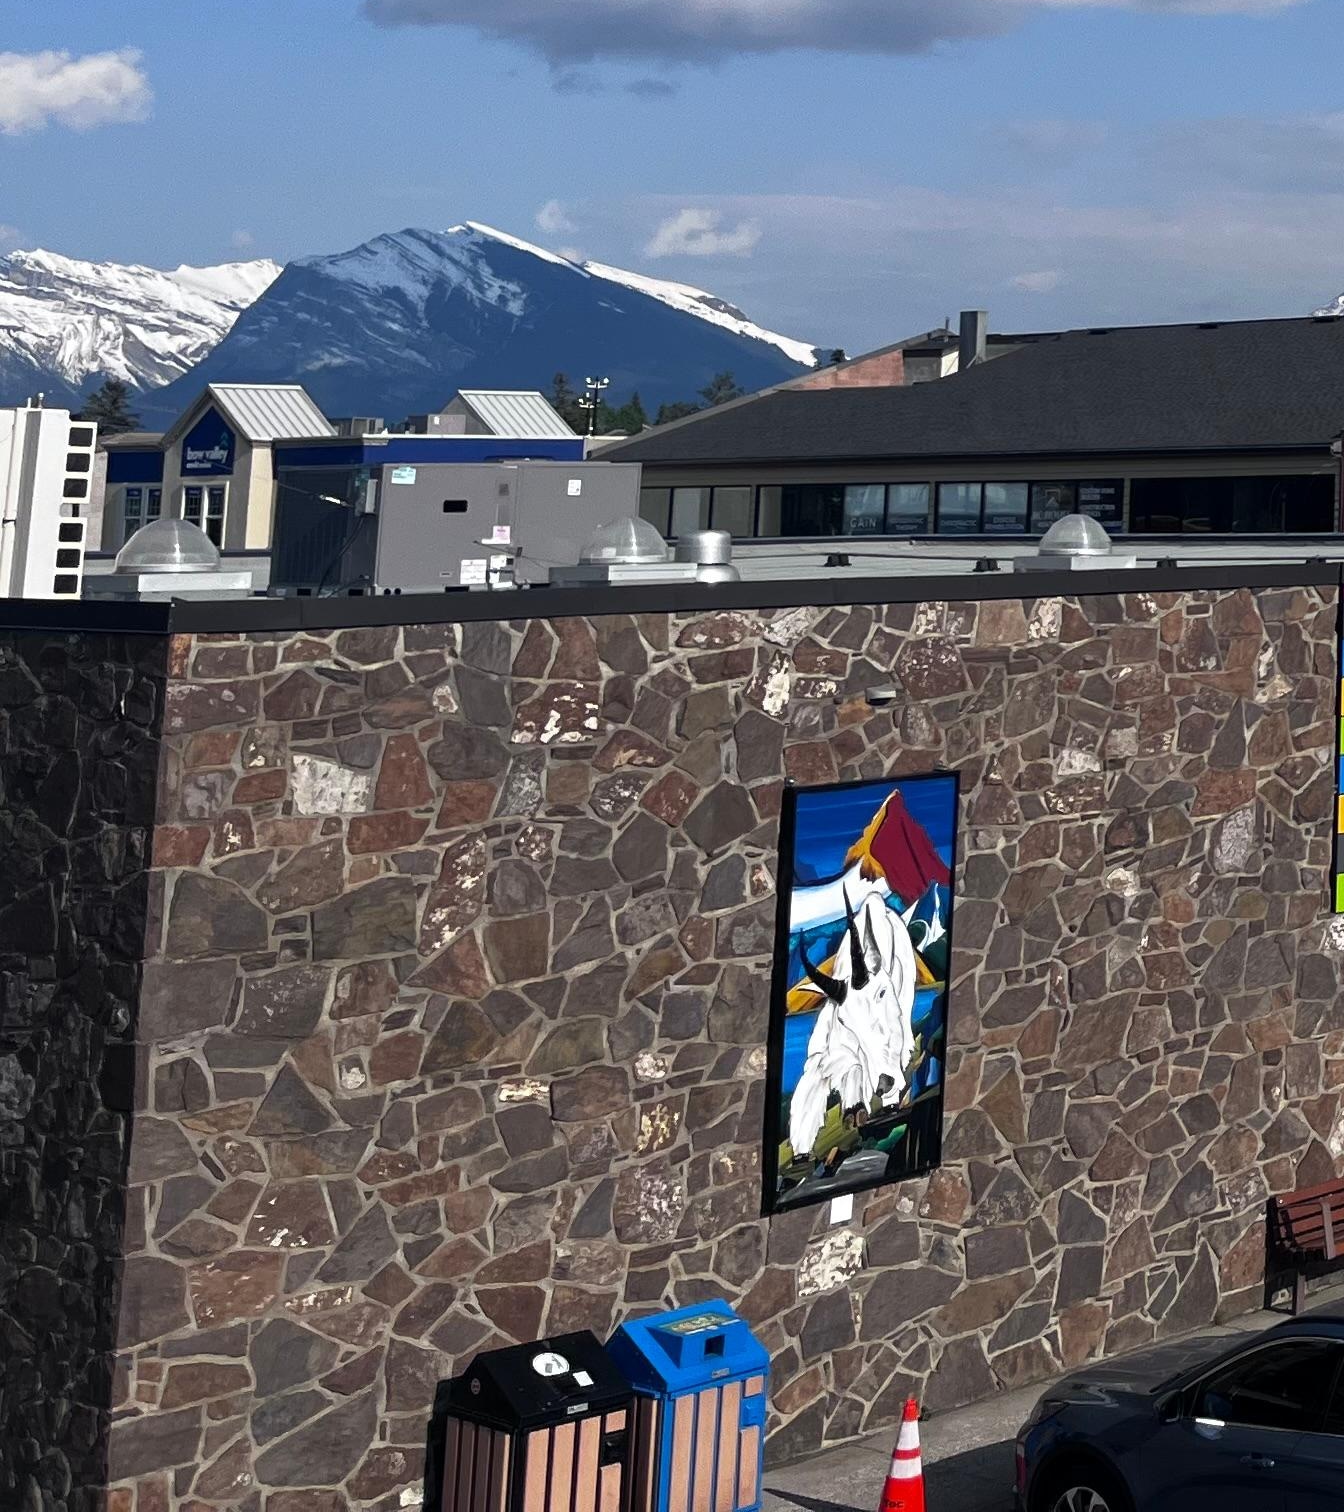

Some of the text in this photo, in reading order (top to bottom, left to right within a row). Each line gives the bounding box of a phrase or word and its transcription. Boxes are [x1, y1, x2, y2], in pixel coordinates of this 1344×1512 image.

[187, 446, 229, 464] bow valley
[849, 517, 876, 528] GAIN
